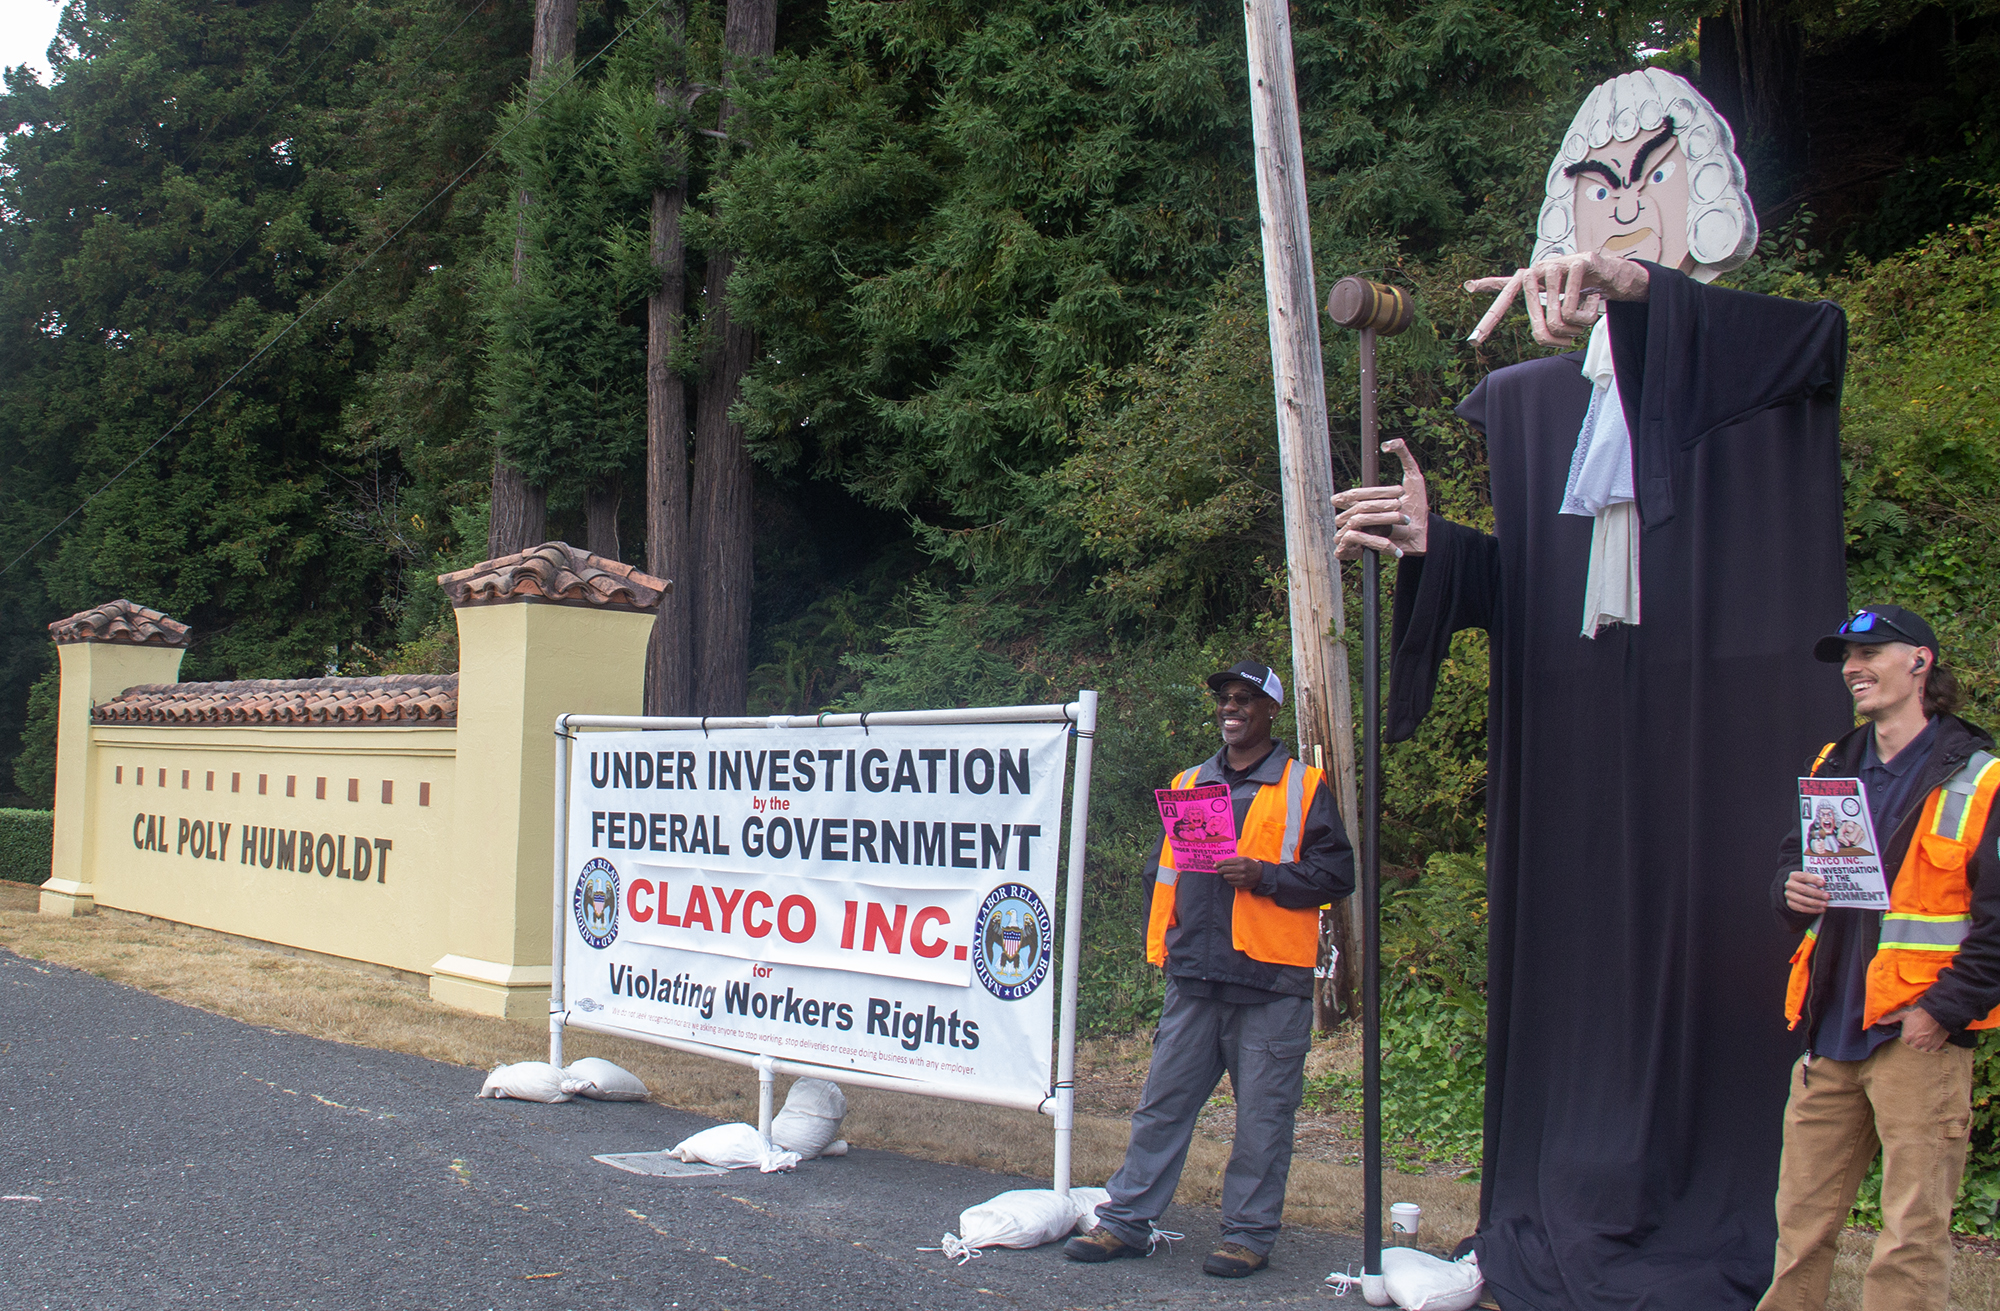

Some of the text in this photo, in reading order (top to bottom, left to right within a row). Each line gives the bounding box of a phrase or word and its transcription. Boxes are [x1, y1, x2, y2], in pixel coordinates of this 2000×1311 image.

[590, 747, 1031, 796] UNDER INVESTIGATION
[753, 796, 790, 813] by the
[133, 812, 393, 884] CAL POLY HUMBOLDT
[591, 811, 1042, 872] FEDERAL GOVERNMENT
[1809, 856, 1864, 865] CLAYCO INC.
[1820, 866, 1880, 874] INVESTIGATION
[1823, 874, 1851, 882] BY THE
[1823, 882, 1863, 891] EDERAL
[1829, 891, 1884, 901] ERNMENT
[626, 878, 969, 962] CLAYCO INC.
[973, 885, 1051, 999] NATIONAL LABOR RELATIONS BOARD
[752, 963, 773, 979] for
[609, 962, 981, 1052] Violating Workers Rights
[691, 1022, 699, 1030] we
[699, 1023, 717, 1035] asking
[718, 1027, 737, 1037] anyone
[738, 1030, 745, 1038] to
[745, 1031, 758, 1042] stop
[758, 1033, 784, 1046] working,
[785, 1037, 799, 1048] stop
[799, 1038, 830, 1052] deliveries
[830, 1045, 838, 1053] or
[838, 1045, 858, 1056] cease
[858, 1047, 878, 1061] doing
[878, 1050, 908, 1064] business
[908, 1056, 925, 1067] with
[926, 1059, 940, 1071] any
[940, 1062, 976, 1076] employer.
